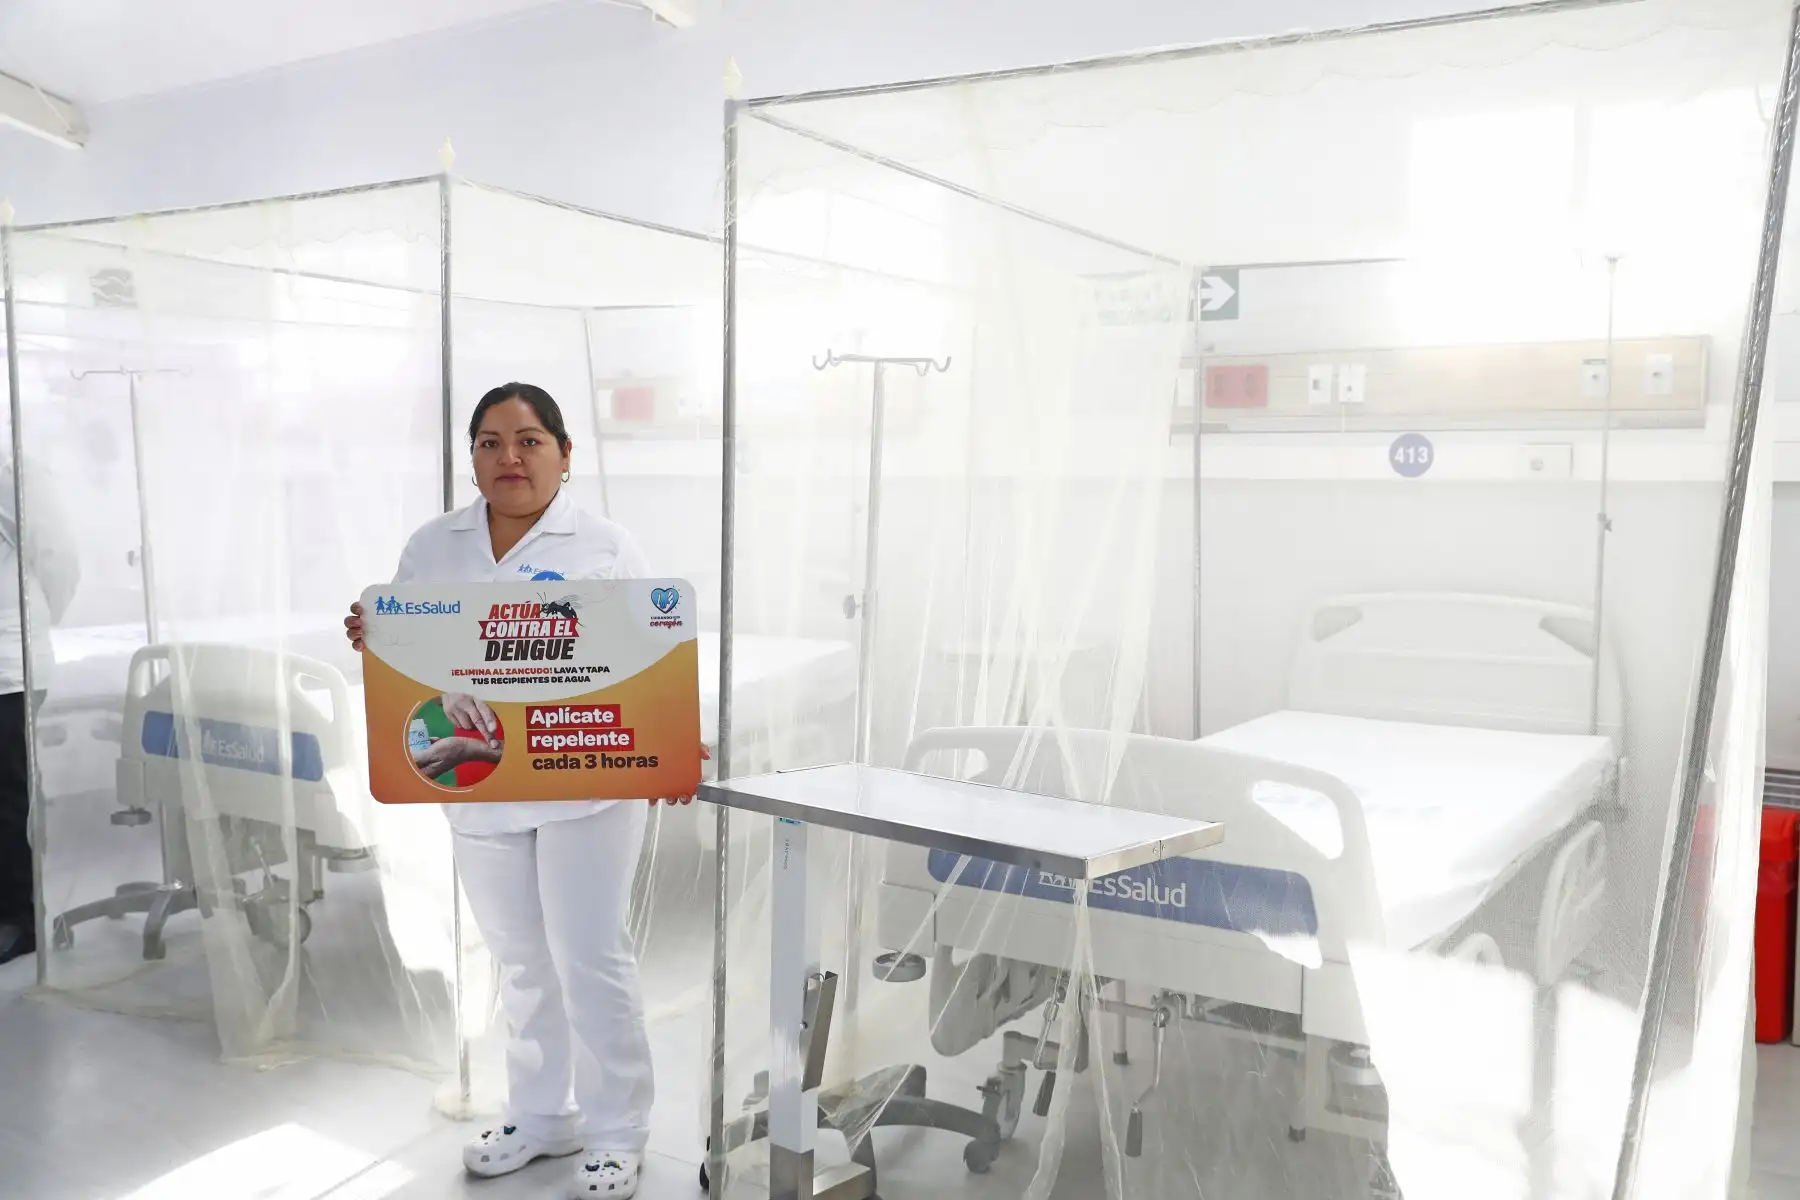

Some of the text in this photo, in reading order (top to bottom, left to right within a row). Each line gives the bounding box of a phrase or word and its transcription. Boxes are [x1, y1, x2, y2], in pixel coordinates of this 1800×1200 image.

[1394, 446, 1428, 464] 413
[405, 600, 461, 615] EsSalud
[488, 601, 541, 619] ACTÚA
[485, 620, 573, 638] CONTRA EL
[485, 639, 575, 661] DENGUE
[451, 668, 492, 676] ¡ELIMINA
[505, 667, 553, 675] ZANCUDO!
[471, 677, 490, 685] TUS
[564, 675, 591, 683] AGUA
[530, 707, 614, 728] Aplícate
[531, 730, 630, 751] repelente
[532, 753, 658, 770] cada 3 horas
